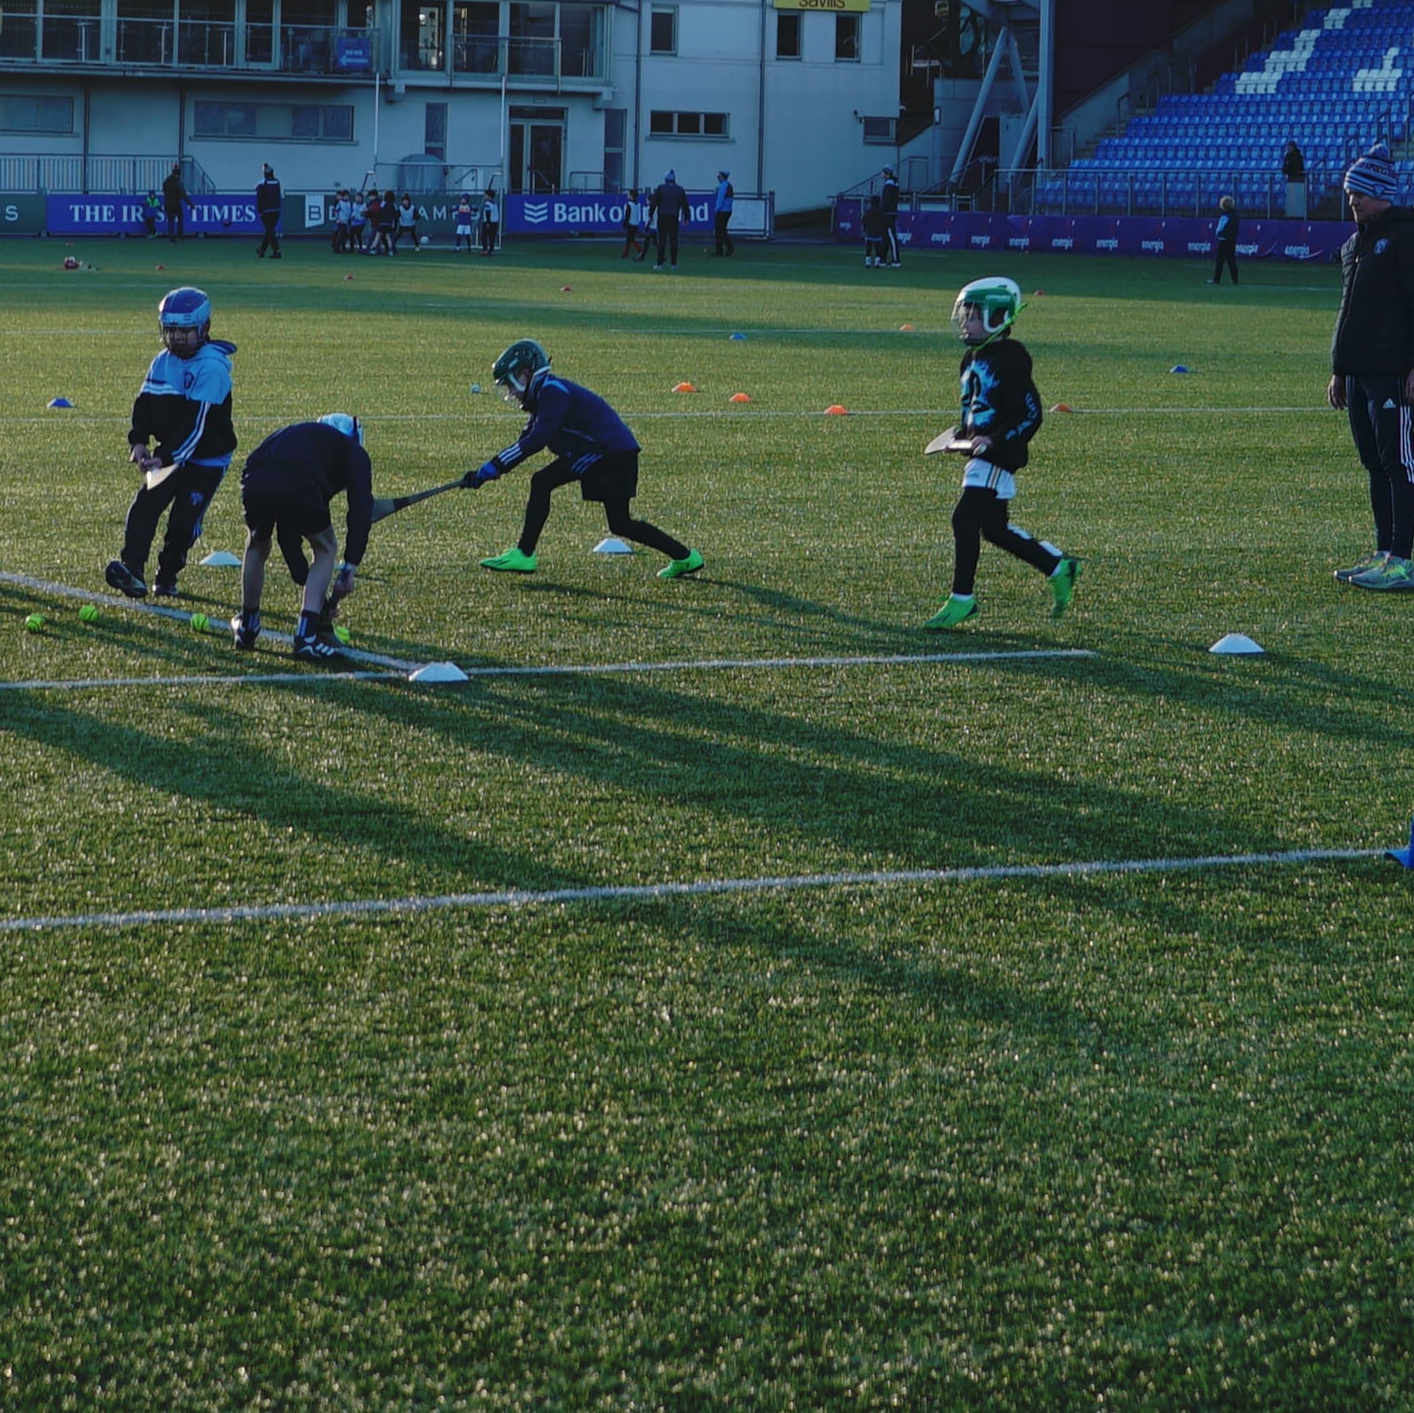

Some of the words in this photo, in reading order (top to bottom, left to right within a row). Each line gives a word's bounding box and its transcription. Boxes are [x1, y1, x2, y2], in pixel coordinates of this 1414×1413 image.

[69, 204, 116, 223] THE
[121, 204, 180, 223] IRS
[187, 204, 257, 223] TIMES
[554, 202, 606, 223] Bank
[609, 202, 626, 223] o
